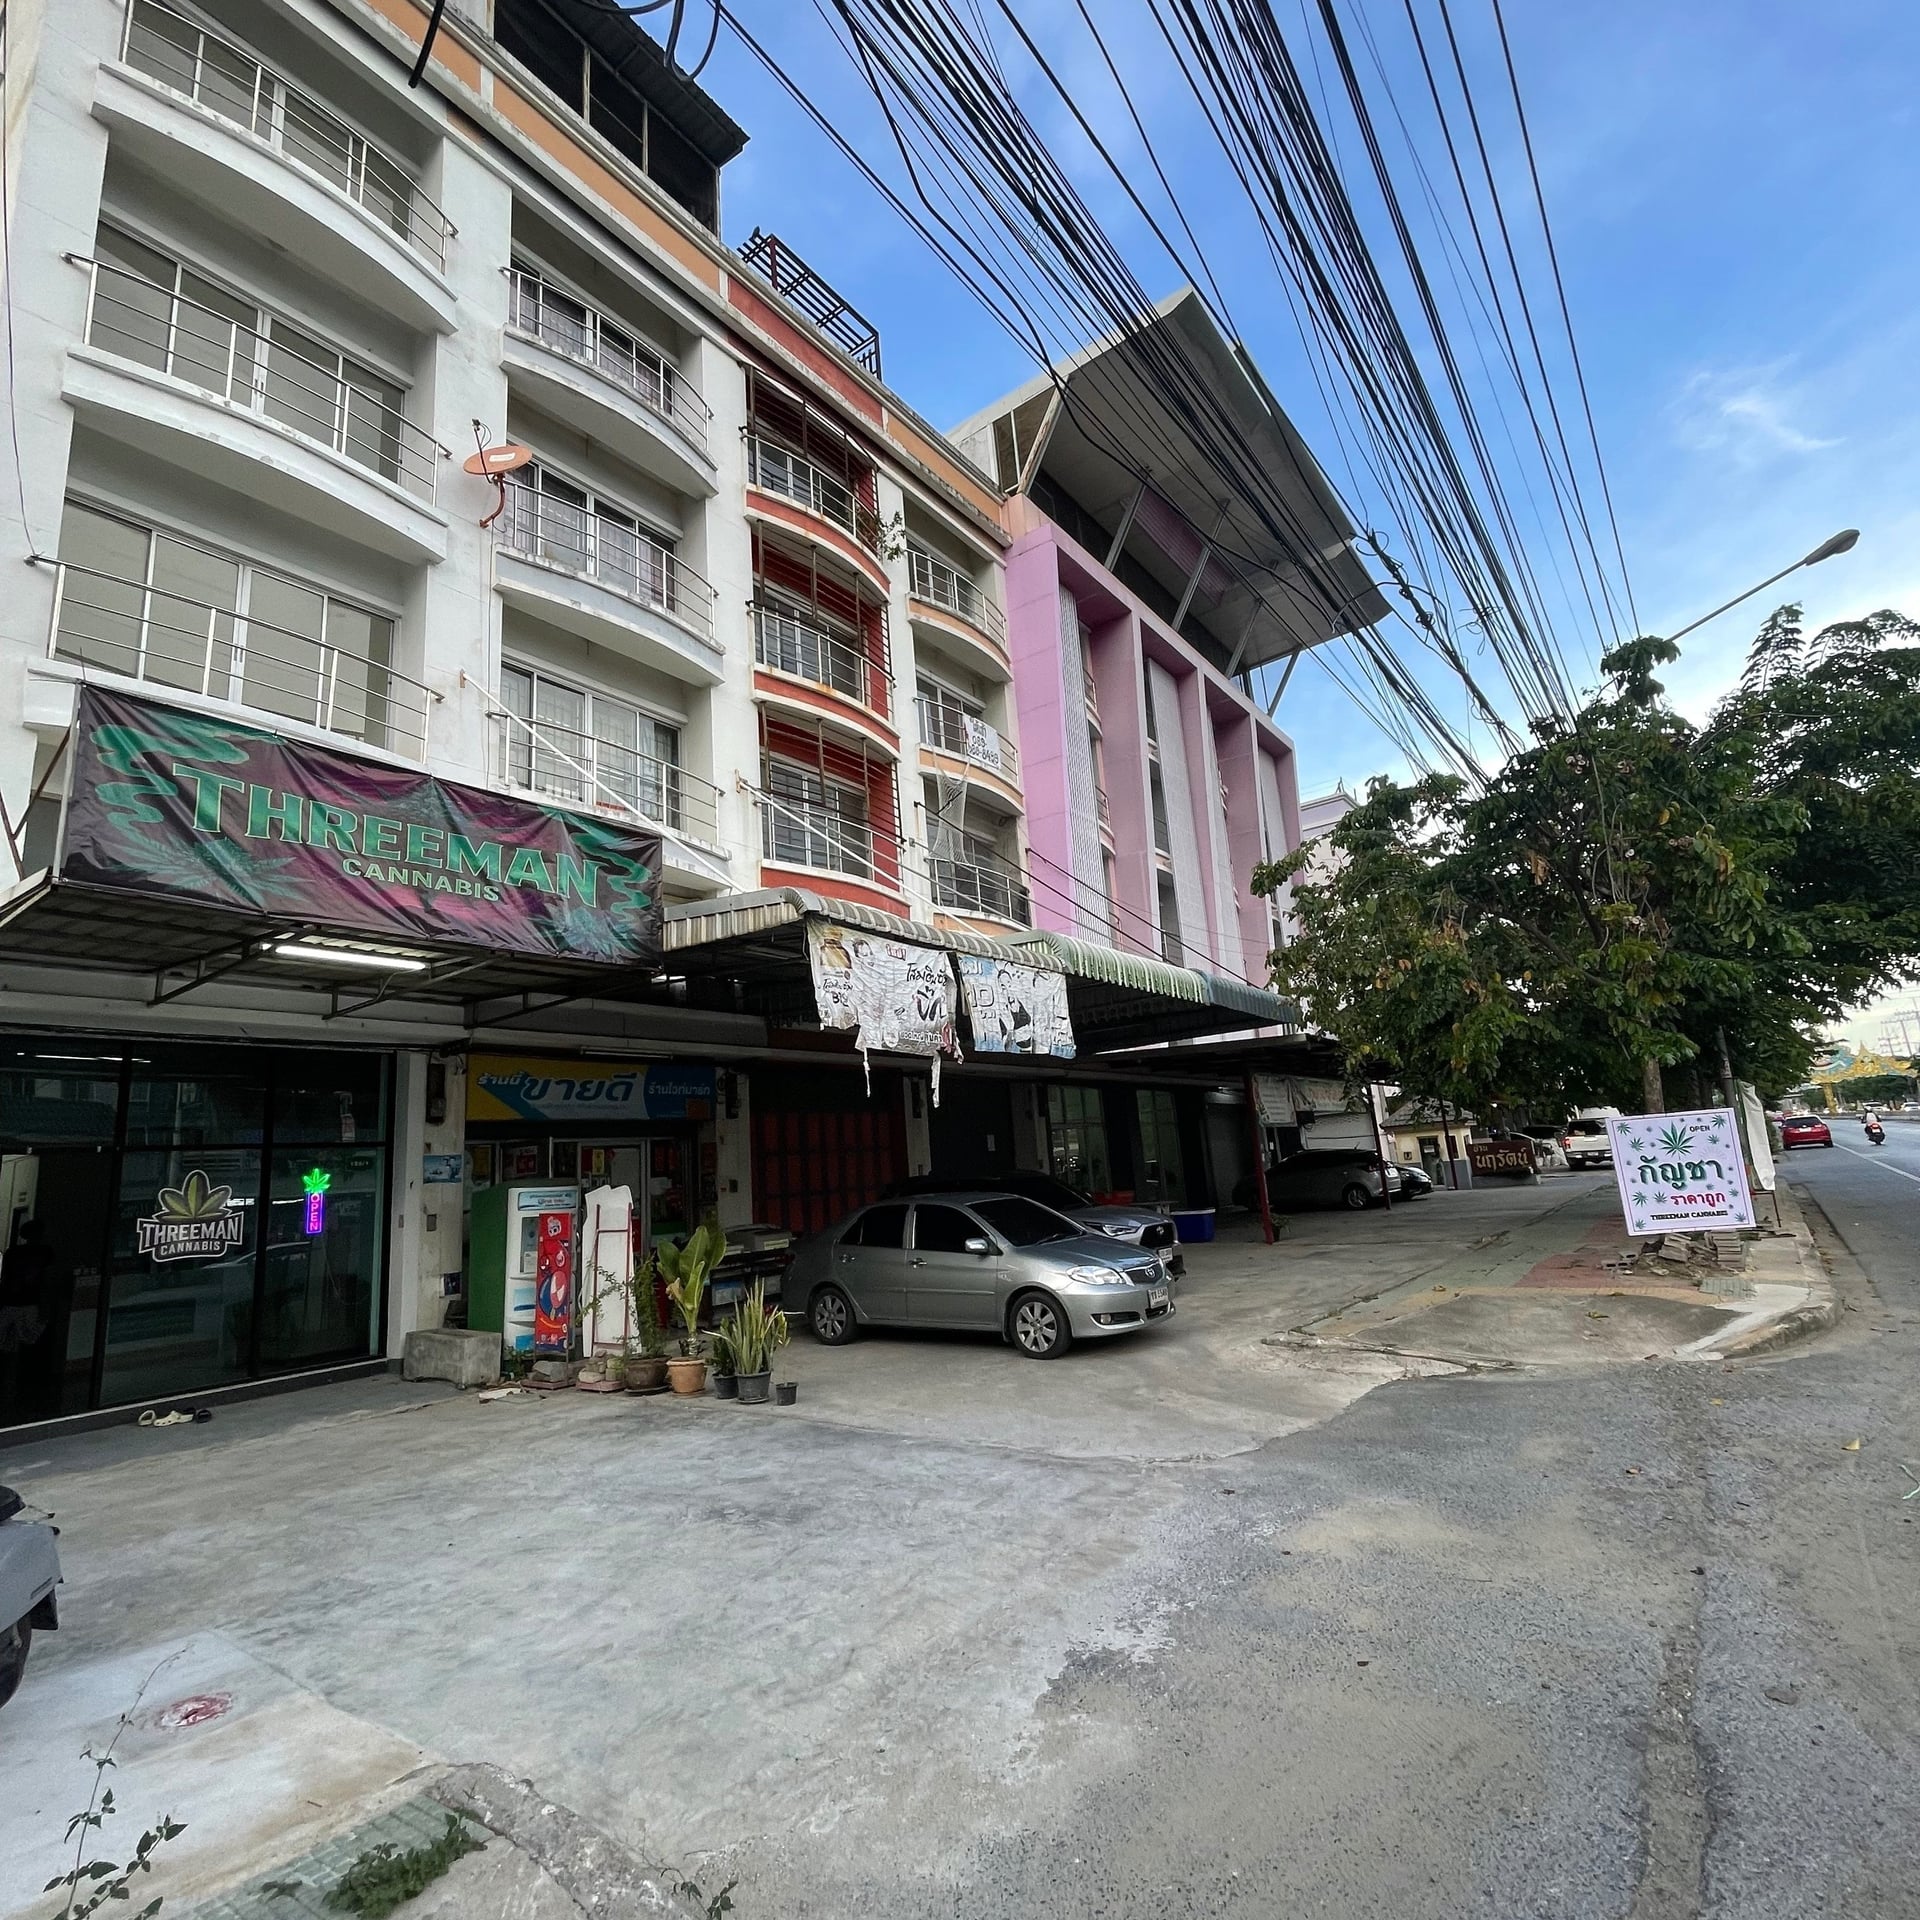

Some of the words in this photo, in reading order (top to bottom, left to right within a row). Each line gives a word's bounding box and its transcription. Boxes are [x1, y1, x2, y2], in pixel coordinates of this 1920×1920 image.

[171, 762, 601, 908] THREEMAN
[341, 856, 500, 903] CANNABIS
[520, 1072, 638, 1102] ขายดี
[1689, 1124, 1711, 1134] OPEN
[1637, 1154, 1725, 1191] กัญชา
[309, 1193, 321, 1231] OPEN
[1670, 1191, 1727, 1208] ราคาถูก
[142, 1216, 240, 1248] THREEMAN
[160, 1240, 221, 1256] CANNABIS
